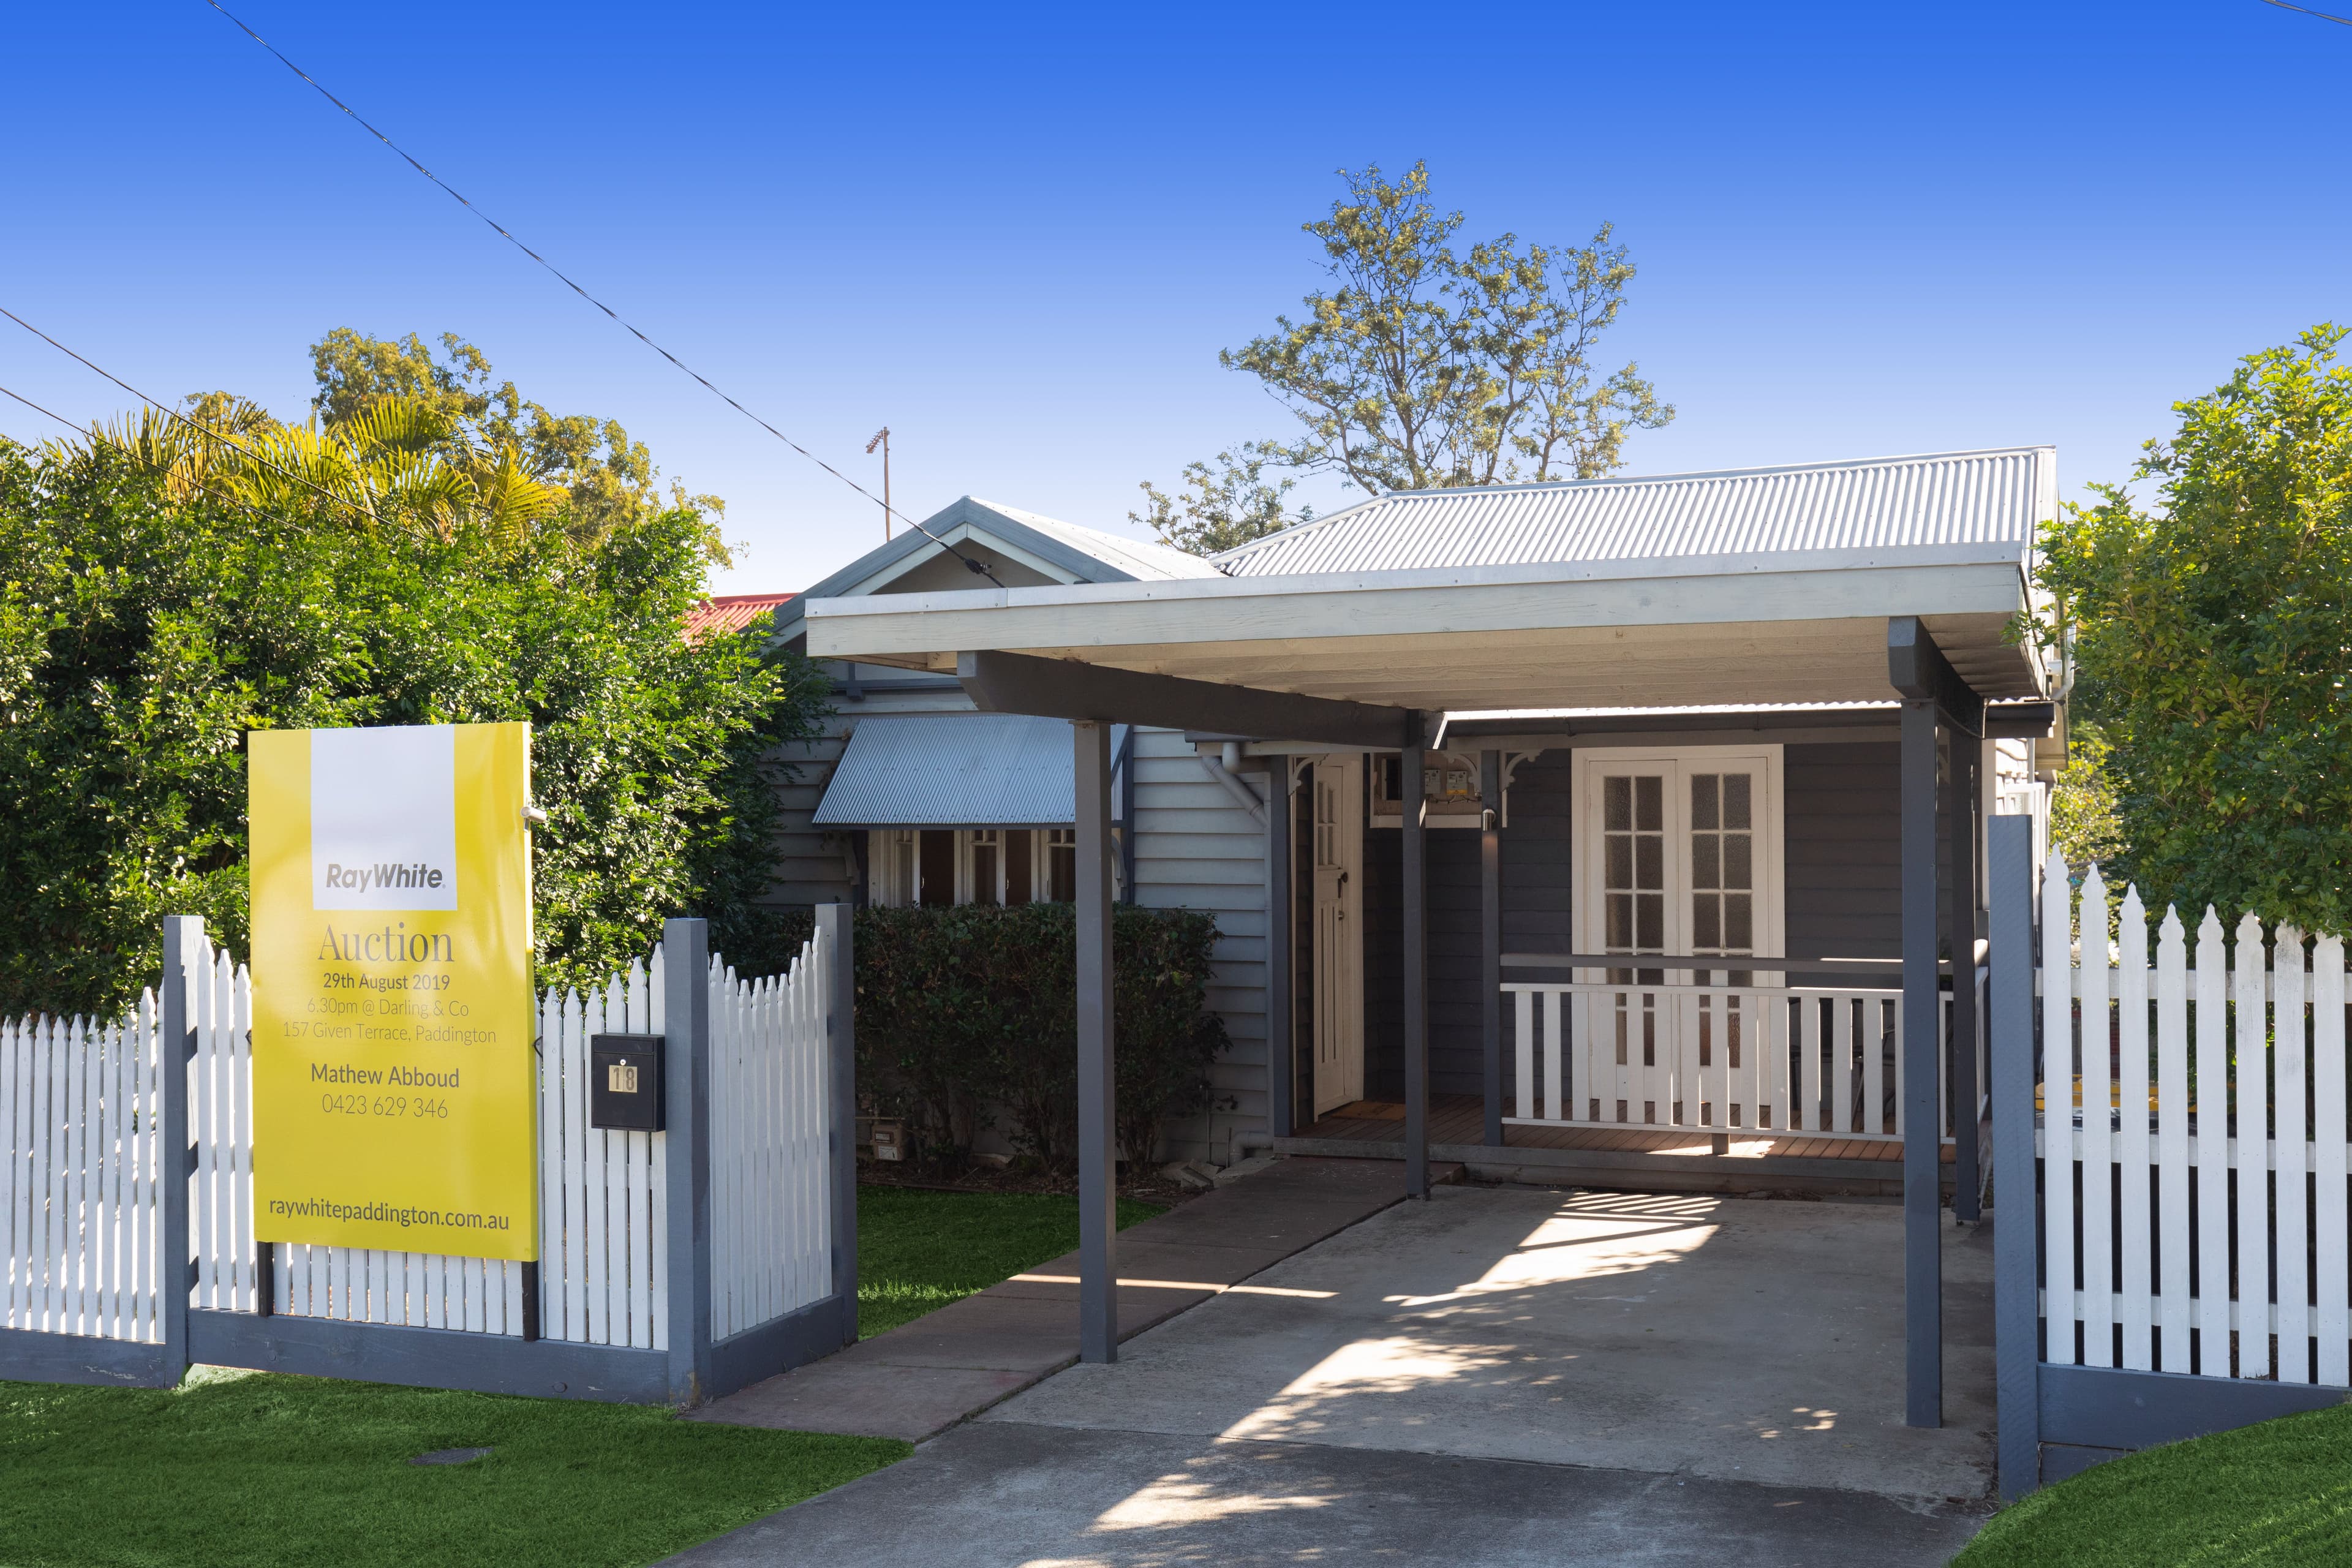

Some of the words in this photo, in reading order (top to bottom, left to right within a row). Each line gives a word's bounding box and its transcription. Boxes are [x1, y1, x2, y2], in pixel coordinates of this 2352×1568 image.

[318, 922, 454, 962] Auction
[323, 973, 355, 989] 29th
[360, 974, 409, 992] August
[413, 975, 450, 990] 2019
[307, 998, 358, 1017] 6.30pm
[363, 1000, 374, 1016] @
[380, 1000, 428, 1018] Darling
[433, 1001, 444, 1016] &
[450, 1001, 469, 1016] Co
[284, 1022, 309, 1037] 157
[314, 1023, 352, 1039] Given
[356, 1024, 410, 1041] Terrace,
[417, 1025, 496, 1046] Paddington
[311, 1063, 383, 1084] Mathew
[388, 1066, 459, 1088] Abboud
[613, 1068, 635, 1091] 18
[322, 1094, 367, 1115] 0423
[374, 1096, 407, 1116] 629
[413, 1098, 448, 1118] 346
[270, 1197, 509, 1230] raywhitepaddington.com.au
